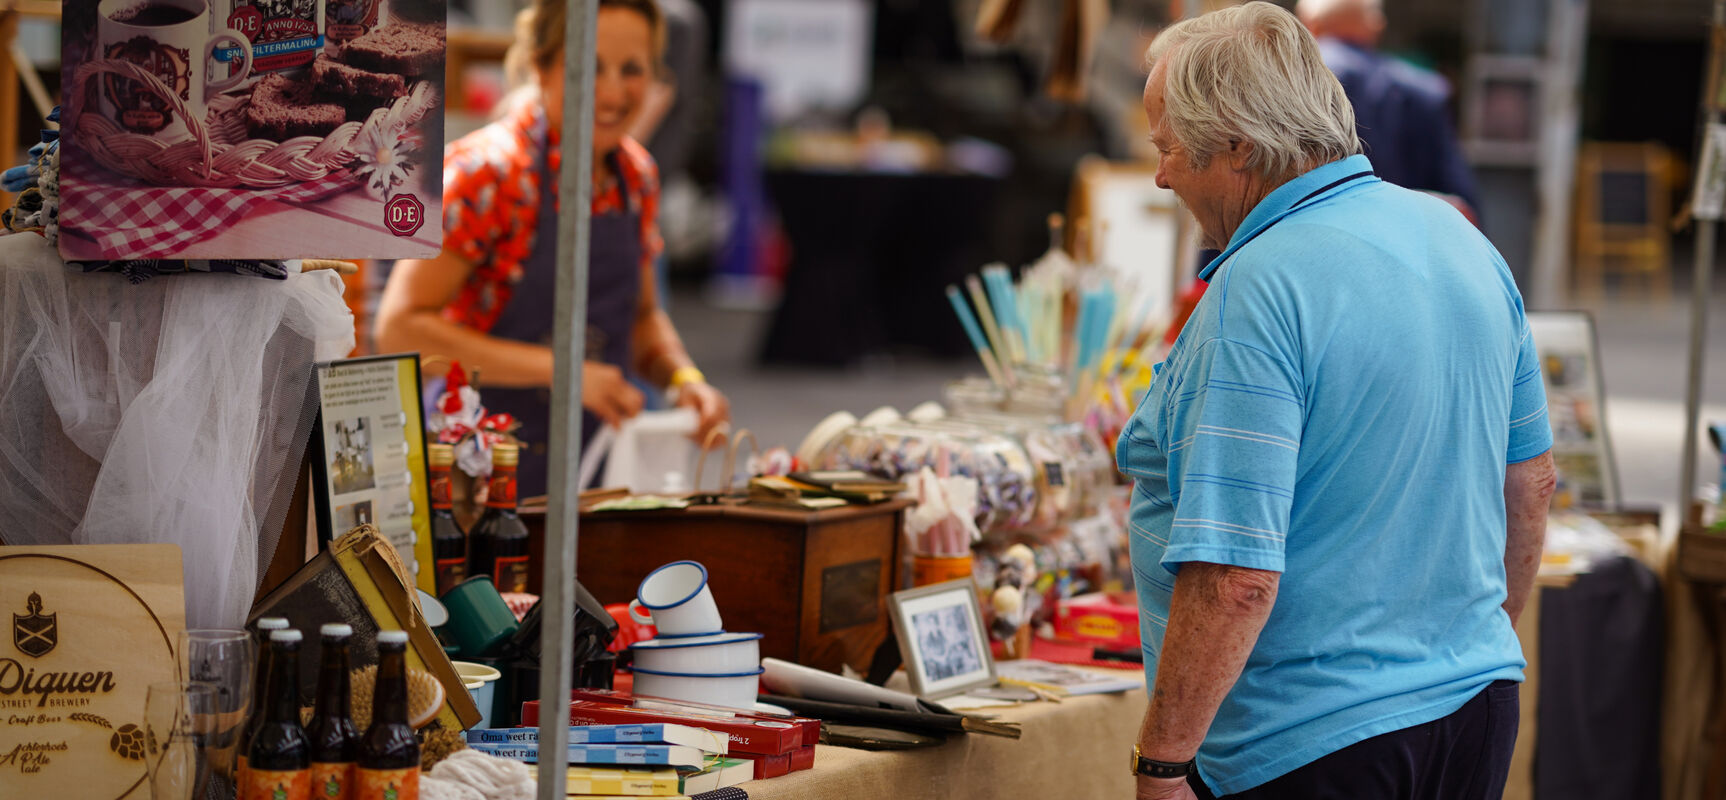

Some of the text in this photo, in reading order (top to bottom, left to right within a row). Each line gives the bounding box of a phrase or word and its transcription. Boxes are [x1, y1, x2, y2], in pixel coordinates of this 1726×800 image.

[266, 20, 293, 31] ANNO
[226, 37, 317, 59] SNEFILTERMALING
[0, 658, 116, 707] Diquen
[1, 698, 91, 709] STREET BREWERY
[8, 713, 62, 726] Craft Beer
[481, 732, 503, 742] Oma
[506, 732, 526, 741] weet
[745, 737, 750, 745] 2
[494, 749, 516, 758] weet
[520, 750, 539, 758] raa
